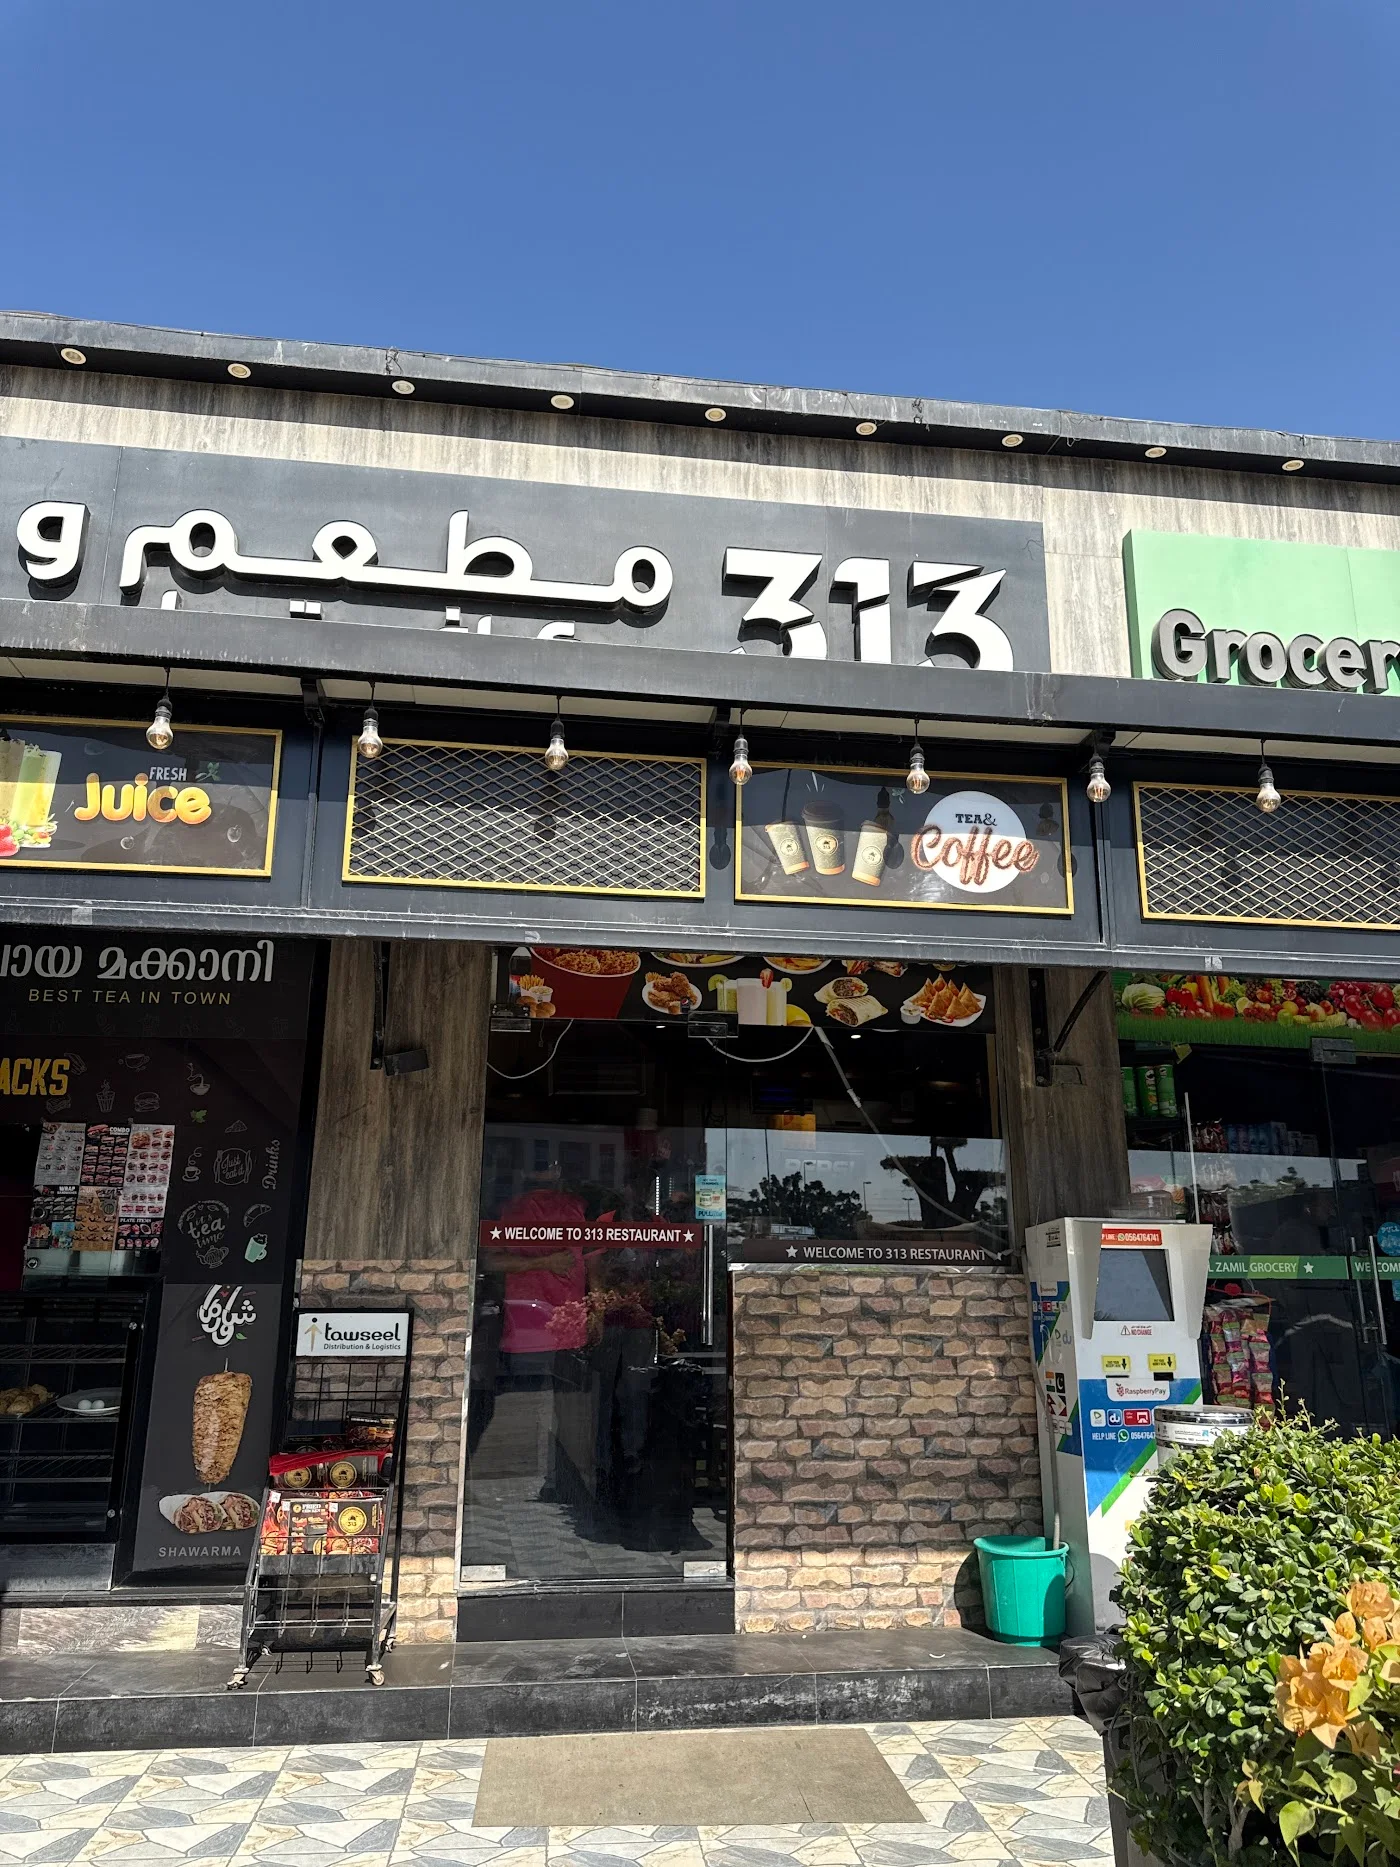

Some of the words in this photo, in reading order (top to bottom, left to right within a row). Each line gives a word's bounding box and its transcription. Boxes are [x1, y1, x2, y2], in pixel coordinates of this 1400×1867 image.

[119, 508, 673, 612] مطعم
[722, 546, 1014, 671] 313
[1151, 608, 1400, 694] Grocer
[149, 766, 188, 781] FRESH
[74, 772, 212, 825] Juice
[911, 824, 1039, 885] Coffee
[97, 939, 275, 982] മക്കാനി
[29, 988, 83, 1003] BEST
[92, 989, 131, 1003] TEA
[141, 990, 160, 1004] IN
[172, 991, 231, 1005] TOWN
[0, 1057, 71, 1096] ACKS
[221, 1154, 242, 1169] Just
[262, 1138, 280, 1190] Drinks
[225, 1169, 238, 1180] eat
[188, 1216, 226, 1239] tea
[504, 1226, 563, 1241] WELCOME
[566, 1227, 581, 1241] TO
[584, 1227, 604, 1241] 313
[606, 1228, 681, 1242] RESTAURANT
[803, 1246, 864, 1259] WELCOME
[866, 1247, 884, 1259] TO
[886, 1248, 908, 1260] 313
[910, 1248, 987, 1261] RESTAURANT
[1215, 1262, 1248, 1272] ZAMIL
[1250, 1262, 1297, 1273] GROCERY
[1354, 1261, 1400, 1272] WECOM
[198, 1284, 257, 1346] شاورما
[324, 1322, 401, 1341] tawseel
[371, 1343, 401, 1352] Logistics
[1124, 1387, 1167, 1396] RaspberryPay
[1109, 1413, 1120, 1423] du
[1092, 1432, 1104, 1441] HELP
[1105, 1432, 1117, 1440] LINE
[1131, 1431, 1156, 1440] 05647647
[158, 1545, 242, 1558] SHAWARMA
